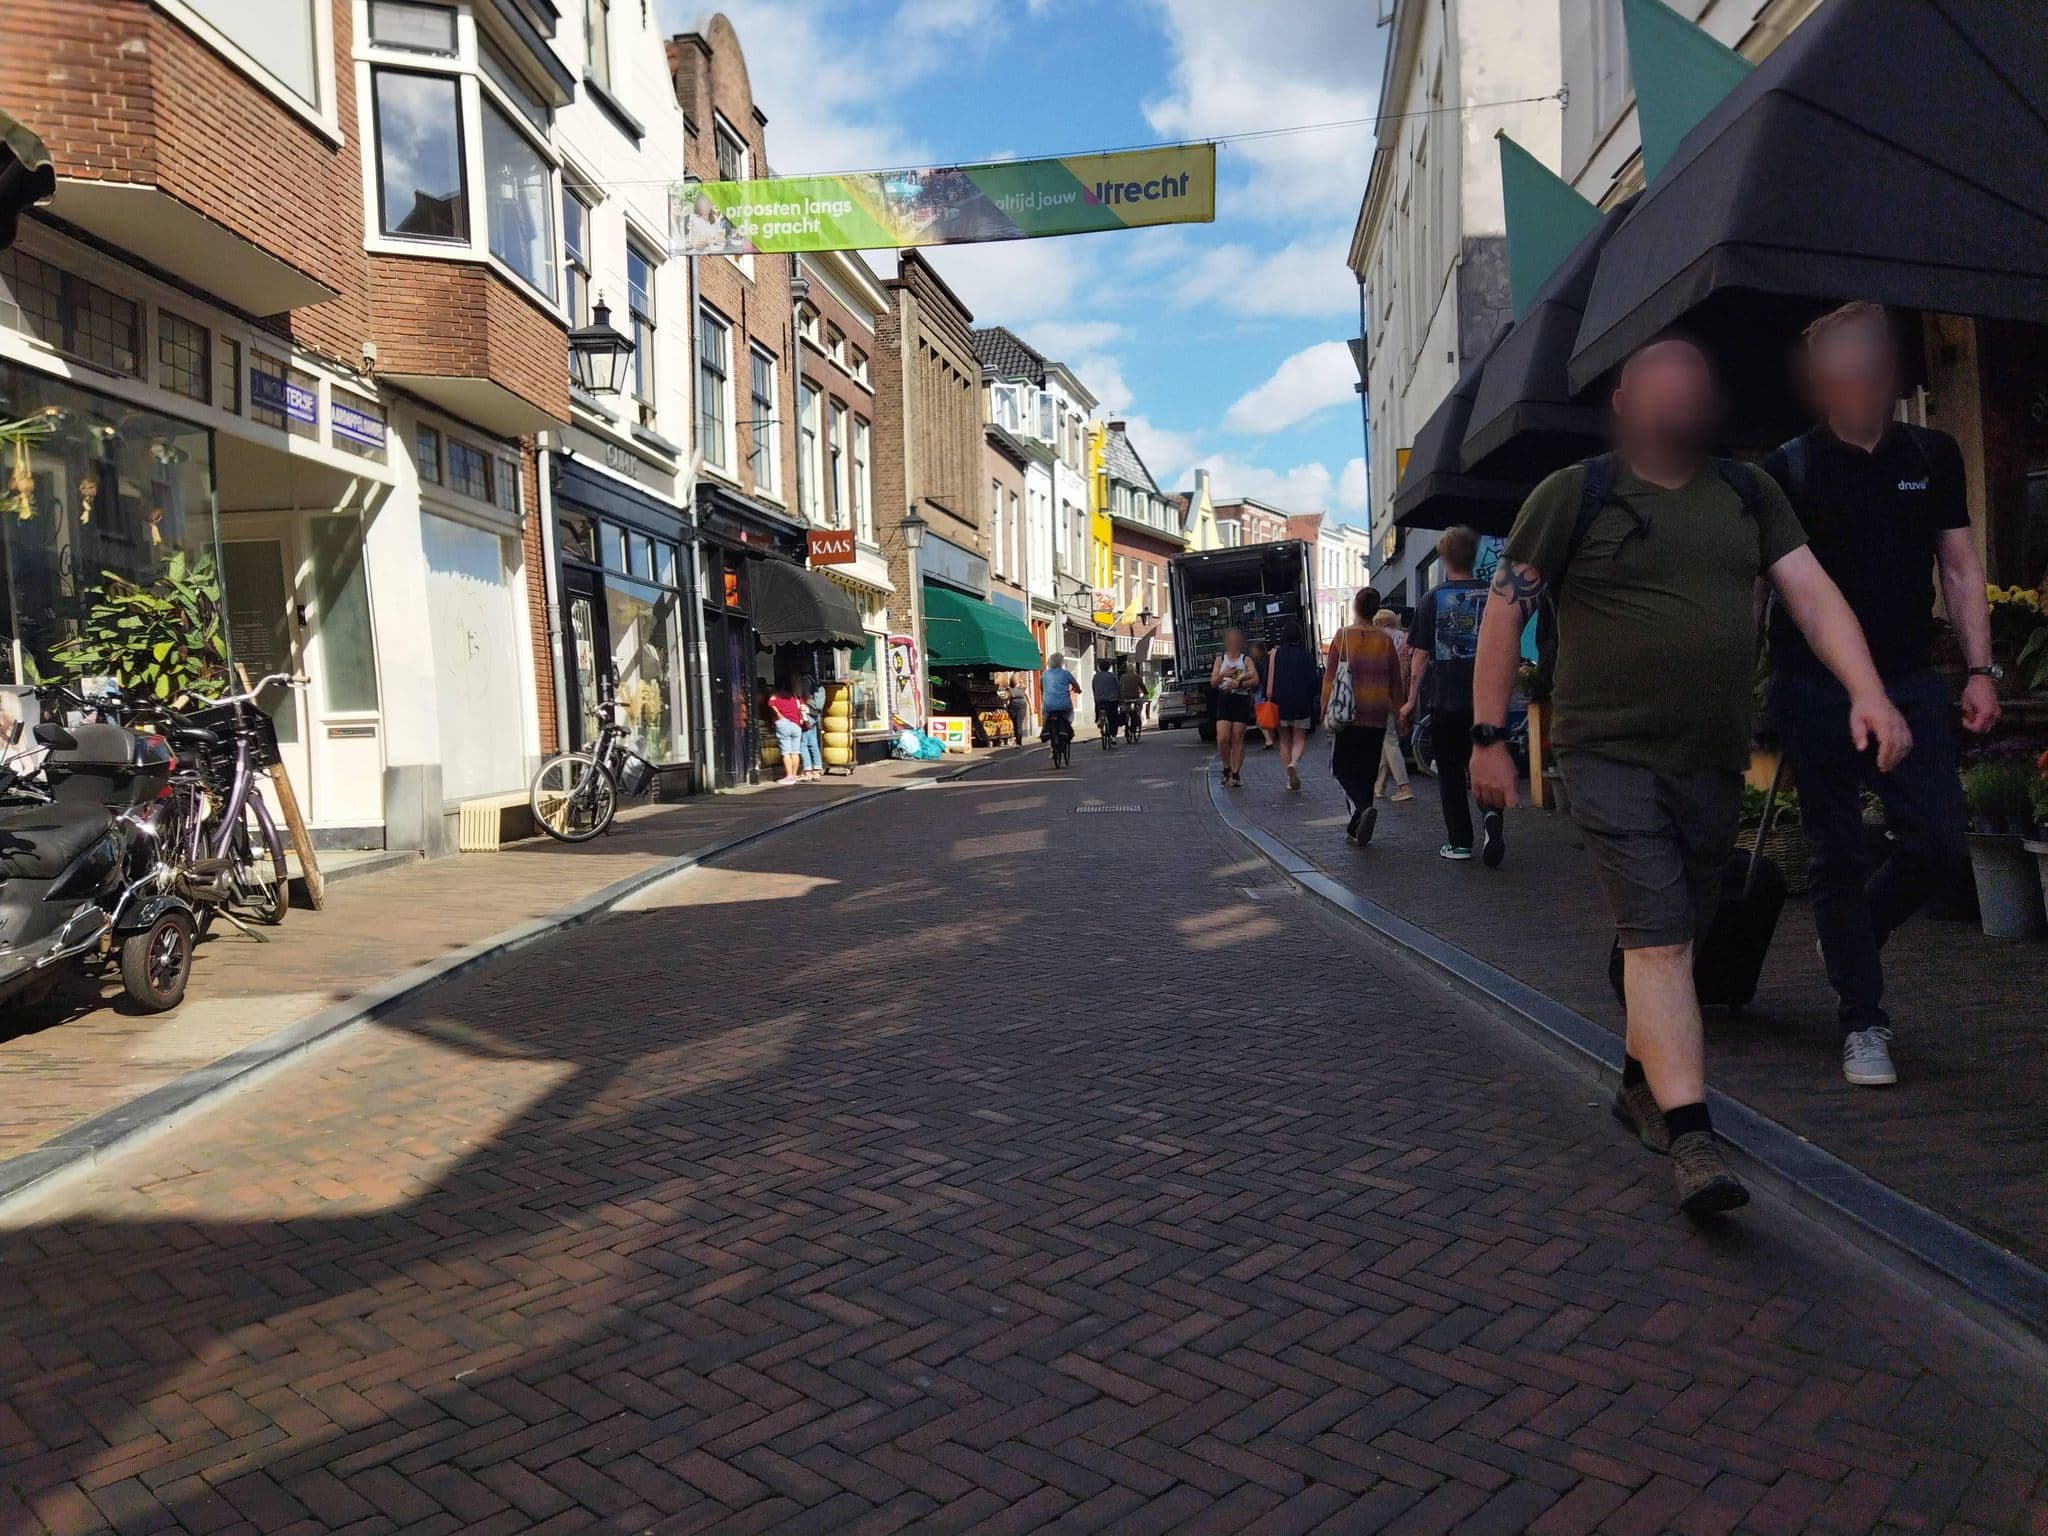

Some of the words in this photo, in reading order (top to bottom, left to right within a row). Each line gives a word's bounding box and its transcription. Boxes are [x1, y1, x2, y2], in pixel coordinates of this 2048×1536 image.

[804, 198, 852, 217] langs
[1036, 191, 1077, 210] jouw
[740, 221, 758, 236] de
[762, 217, 821, 239] gracht
[812, 539, 851, 555] KAAS
